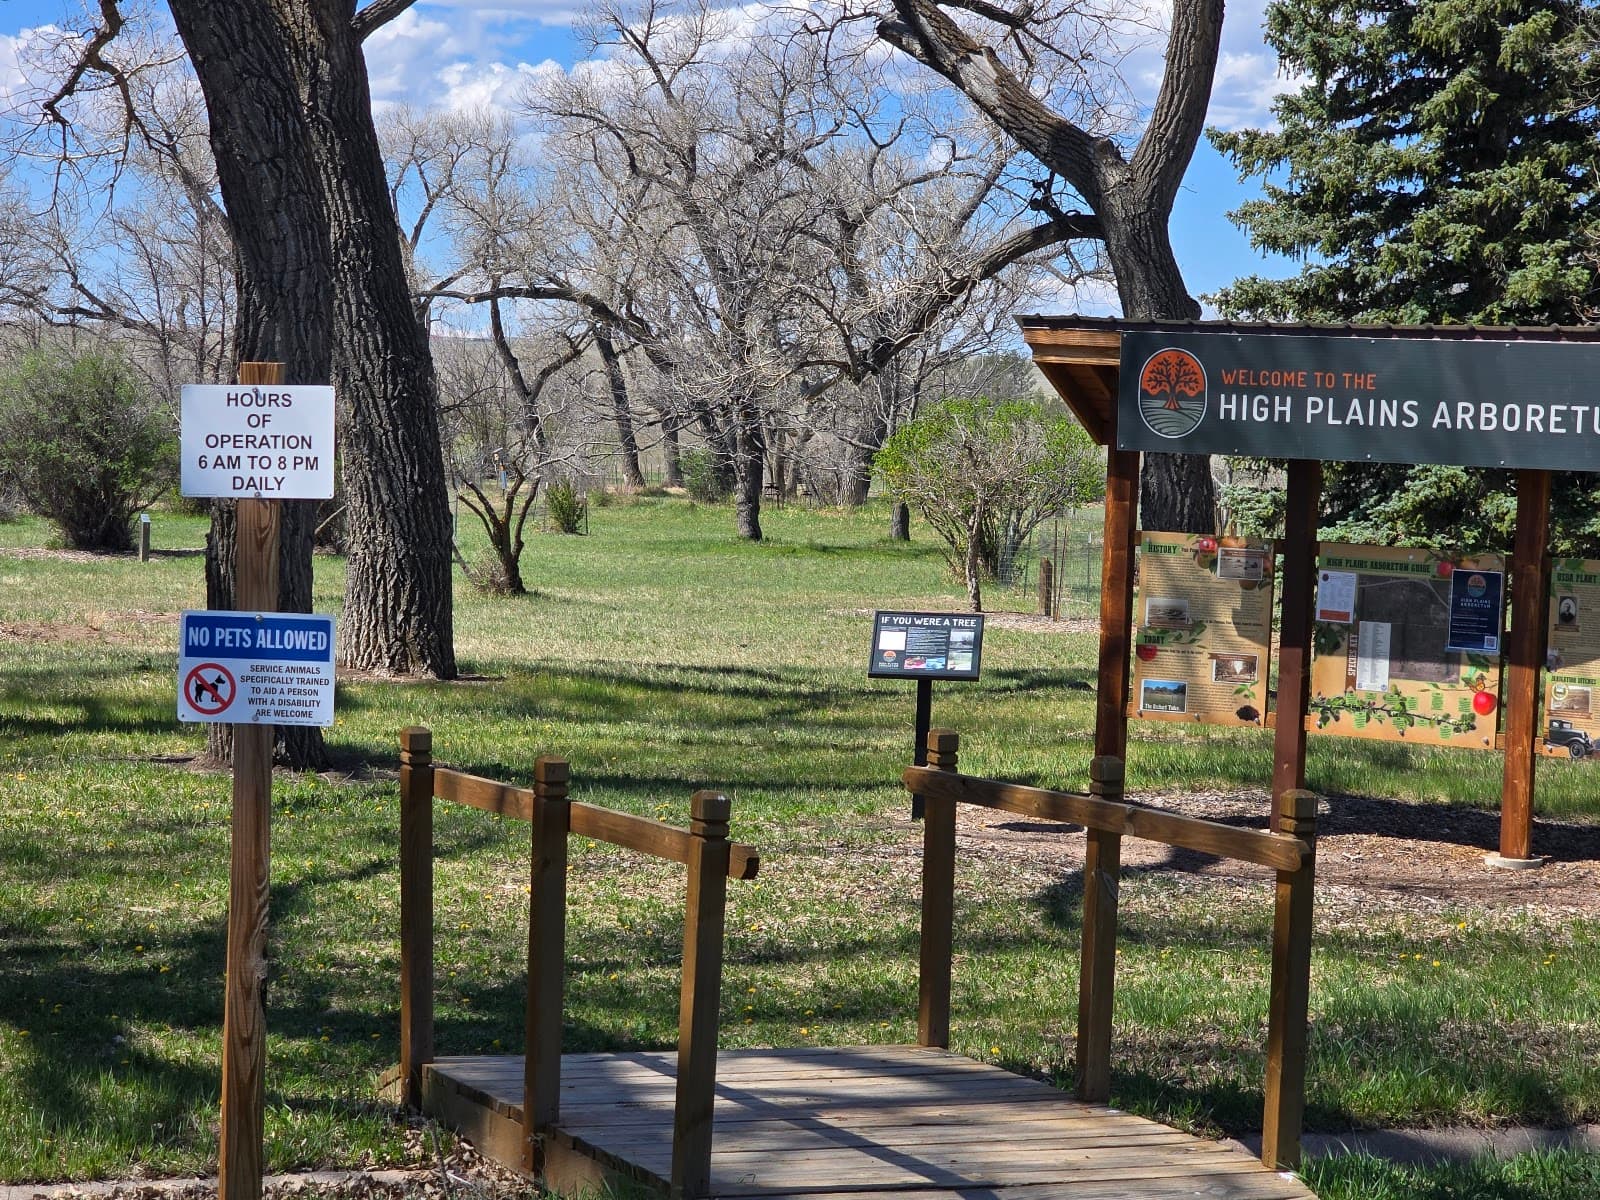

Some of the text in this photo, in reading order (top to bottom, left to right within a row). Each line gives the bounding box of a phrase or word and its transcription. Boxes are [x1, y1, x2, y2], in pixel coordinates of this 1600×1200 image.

[1222, 369, 1377, 390] WELCOME TO THE
[226, 392, 292, 408] HOURS
[1219, 394, 1292, 423] HIGH
[1306, 396, 1418, 429] PLAINS
[247, 414, 272, 428] OF
[205, 434, 312, 449] OPERATION
[198, 455, 319, 470] 6 AM TO 8 PM
[232, 476, 285, 491] DAILY
[1148, 543, 1177, 554] HISTORY
[881, 616, 977, 627] IF YOU WERE A TREE
[188, 626, 327, 651] NO PETS ALLOWED
[250, 665, 321, 674] SERVICE ANIMALS
[240, 675, 330, 686] SPECIFICALLY TRAINED
[251, 687, 319, 696] TO AID A PERSON
[248, 697, 321, 707] WITH A DISABILITY
[255, 708, 313, 719] ARE WELCOME
